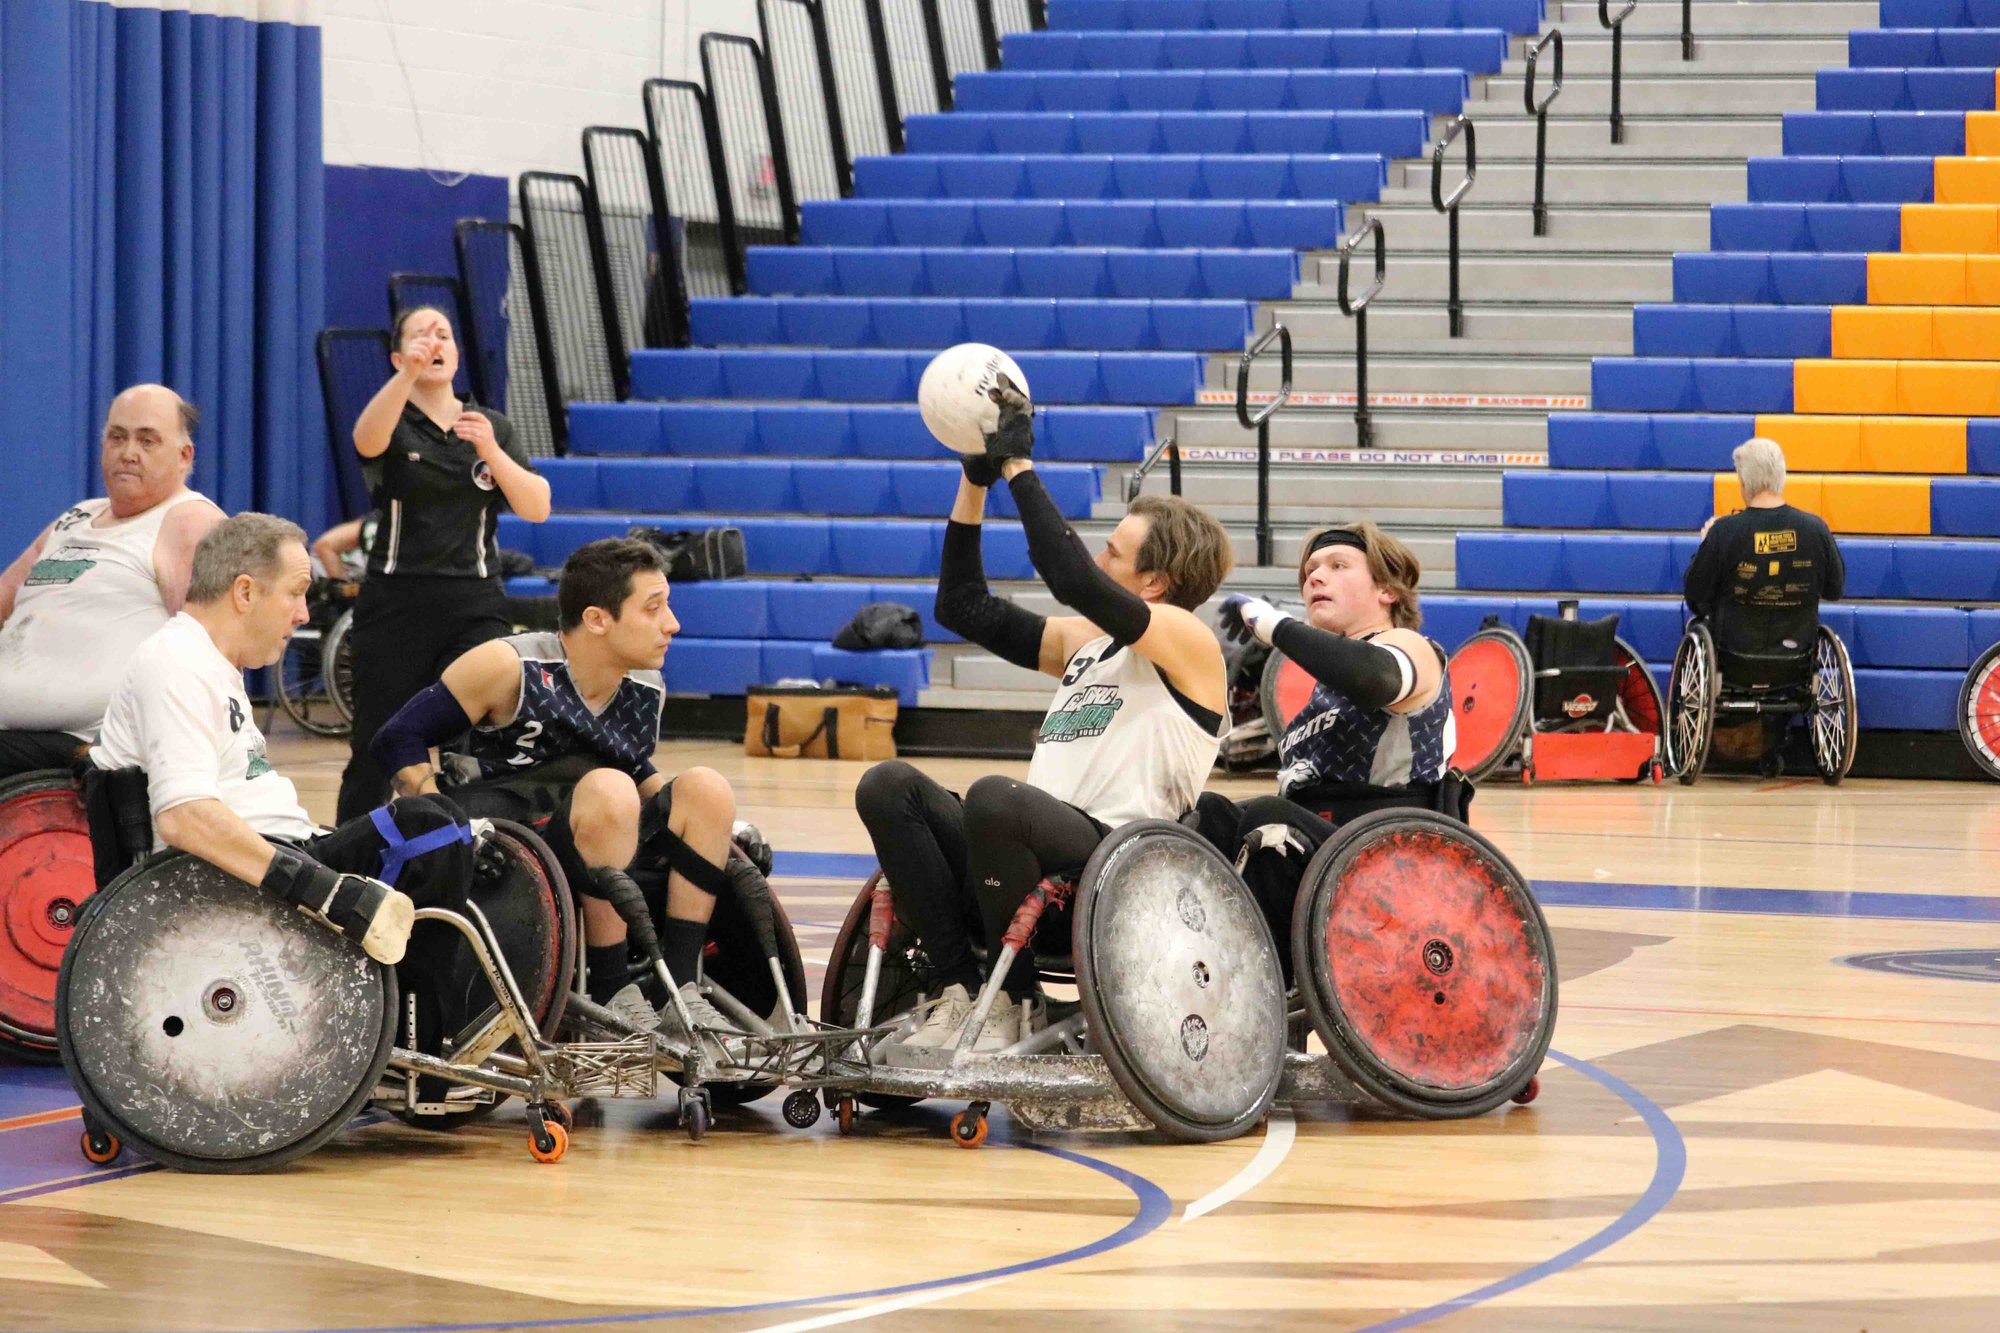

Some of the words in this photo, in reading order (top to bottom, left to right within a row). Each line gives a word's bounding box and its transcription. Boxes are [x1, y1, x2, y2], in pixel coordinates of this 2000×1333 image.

[1336, 395, 1378, 403] THRW
[1188, 450, 1271, 460] CAUTIO
[1279, 452, 1351, 461] PLEASE
[1359, 453, 1386, 462] DO
[1393, 454, 1432, 462] NOT
[515, 720, 544, 749] 2
[984, 877, 1001, 887] alo
